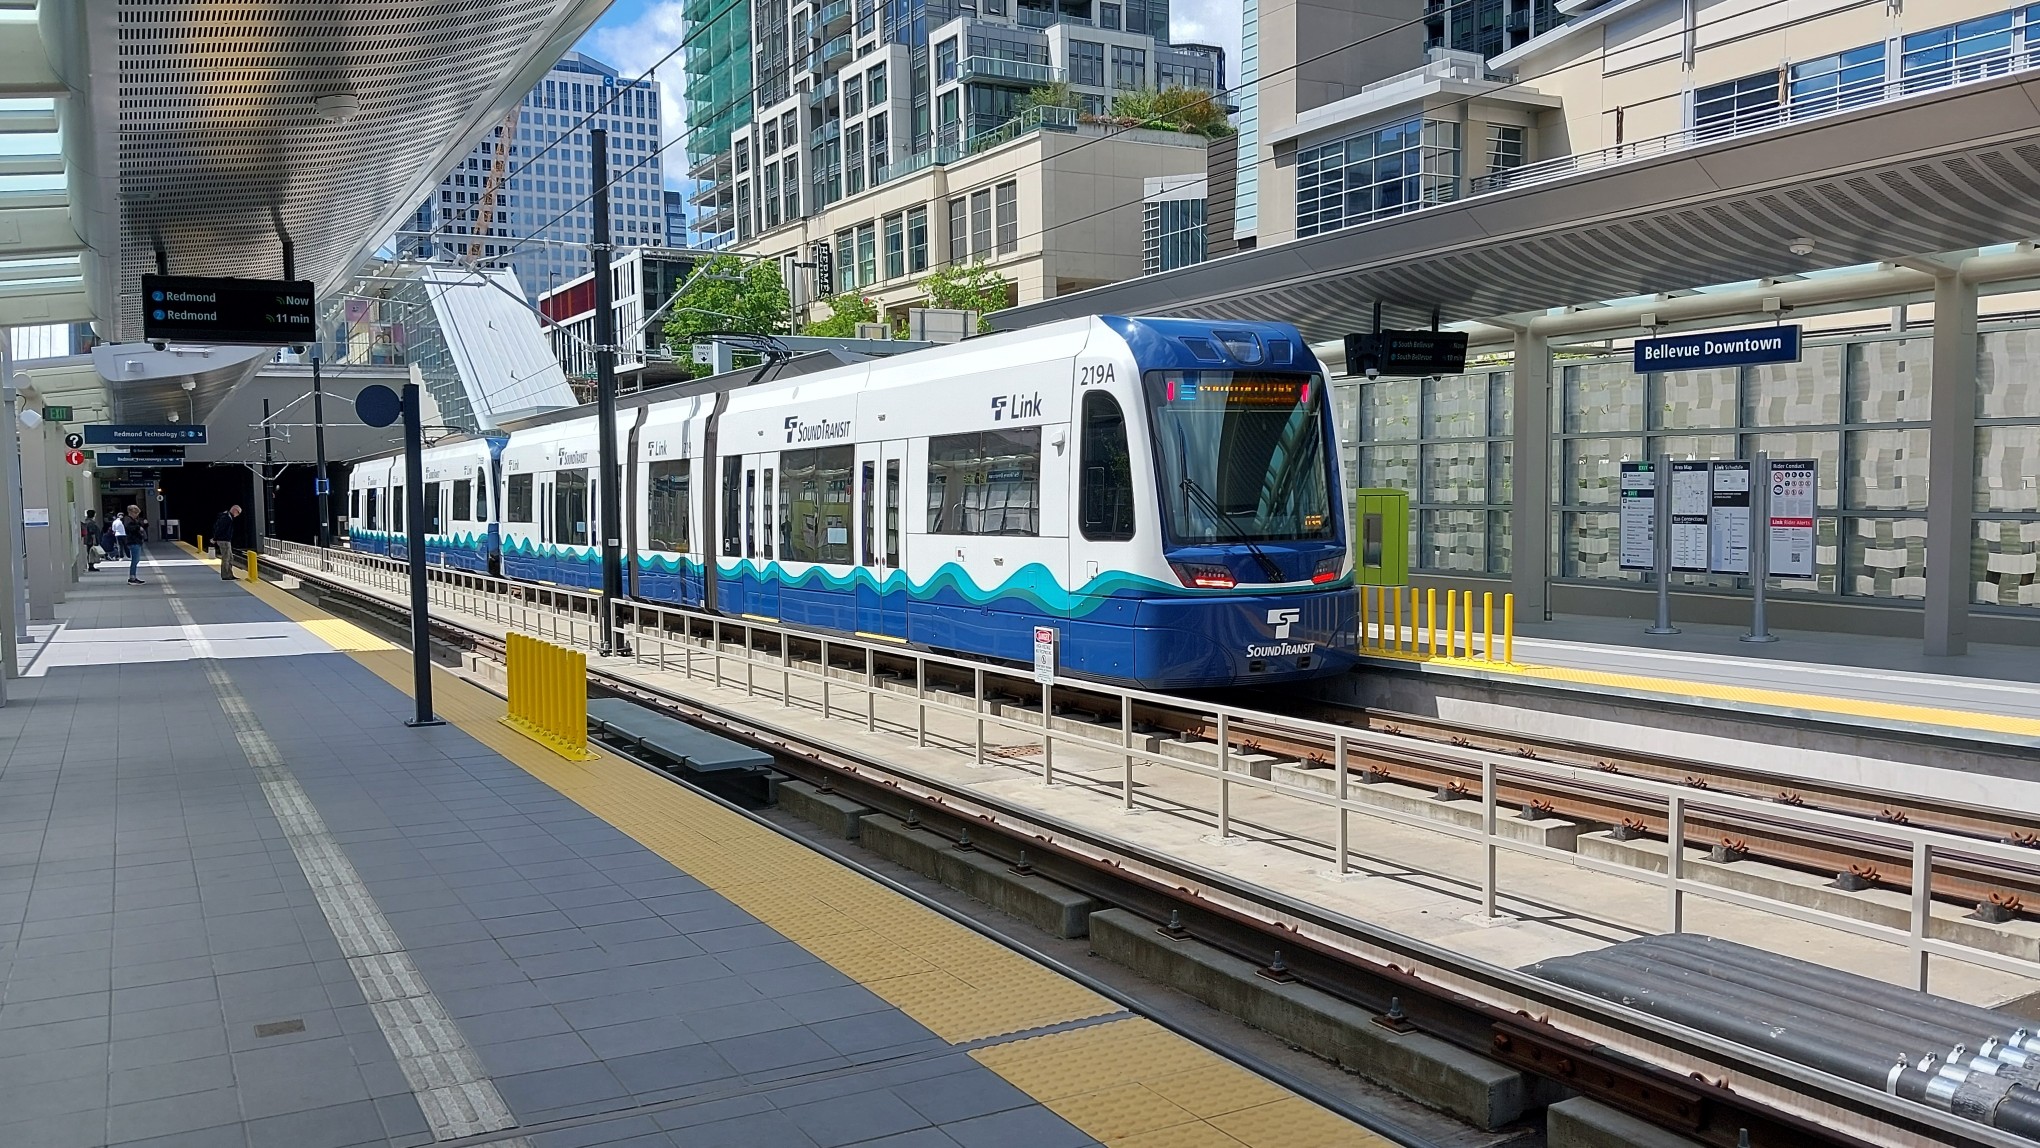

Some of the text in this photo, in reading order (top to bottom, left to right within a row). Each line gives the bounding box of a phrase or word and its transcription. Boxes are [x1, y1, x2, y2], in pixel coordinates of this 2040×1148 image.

[166, 292, 216, 302] Redmond
[286, 296, 309, 306] Now
[168, 310, 217, 321] Redmond
[276, 314, 287, 322] 11
[290, 314, 310, 324] min
[1645, 338, 1782, 360] Bellevue Downtown
[1080, 363, 1115, 386] 219A
[50, 408, 67, 418] EXIT
[1011, 391, 1042, 419] Link
[656, 440, 668, 456] Link
